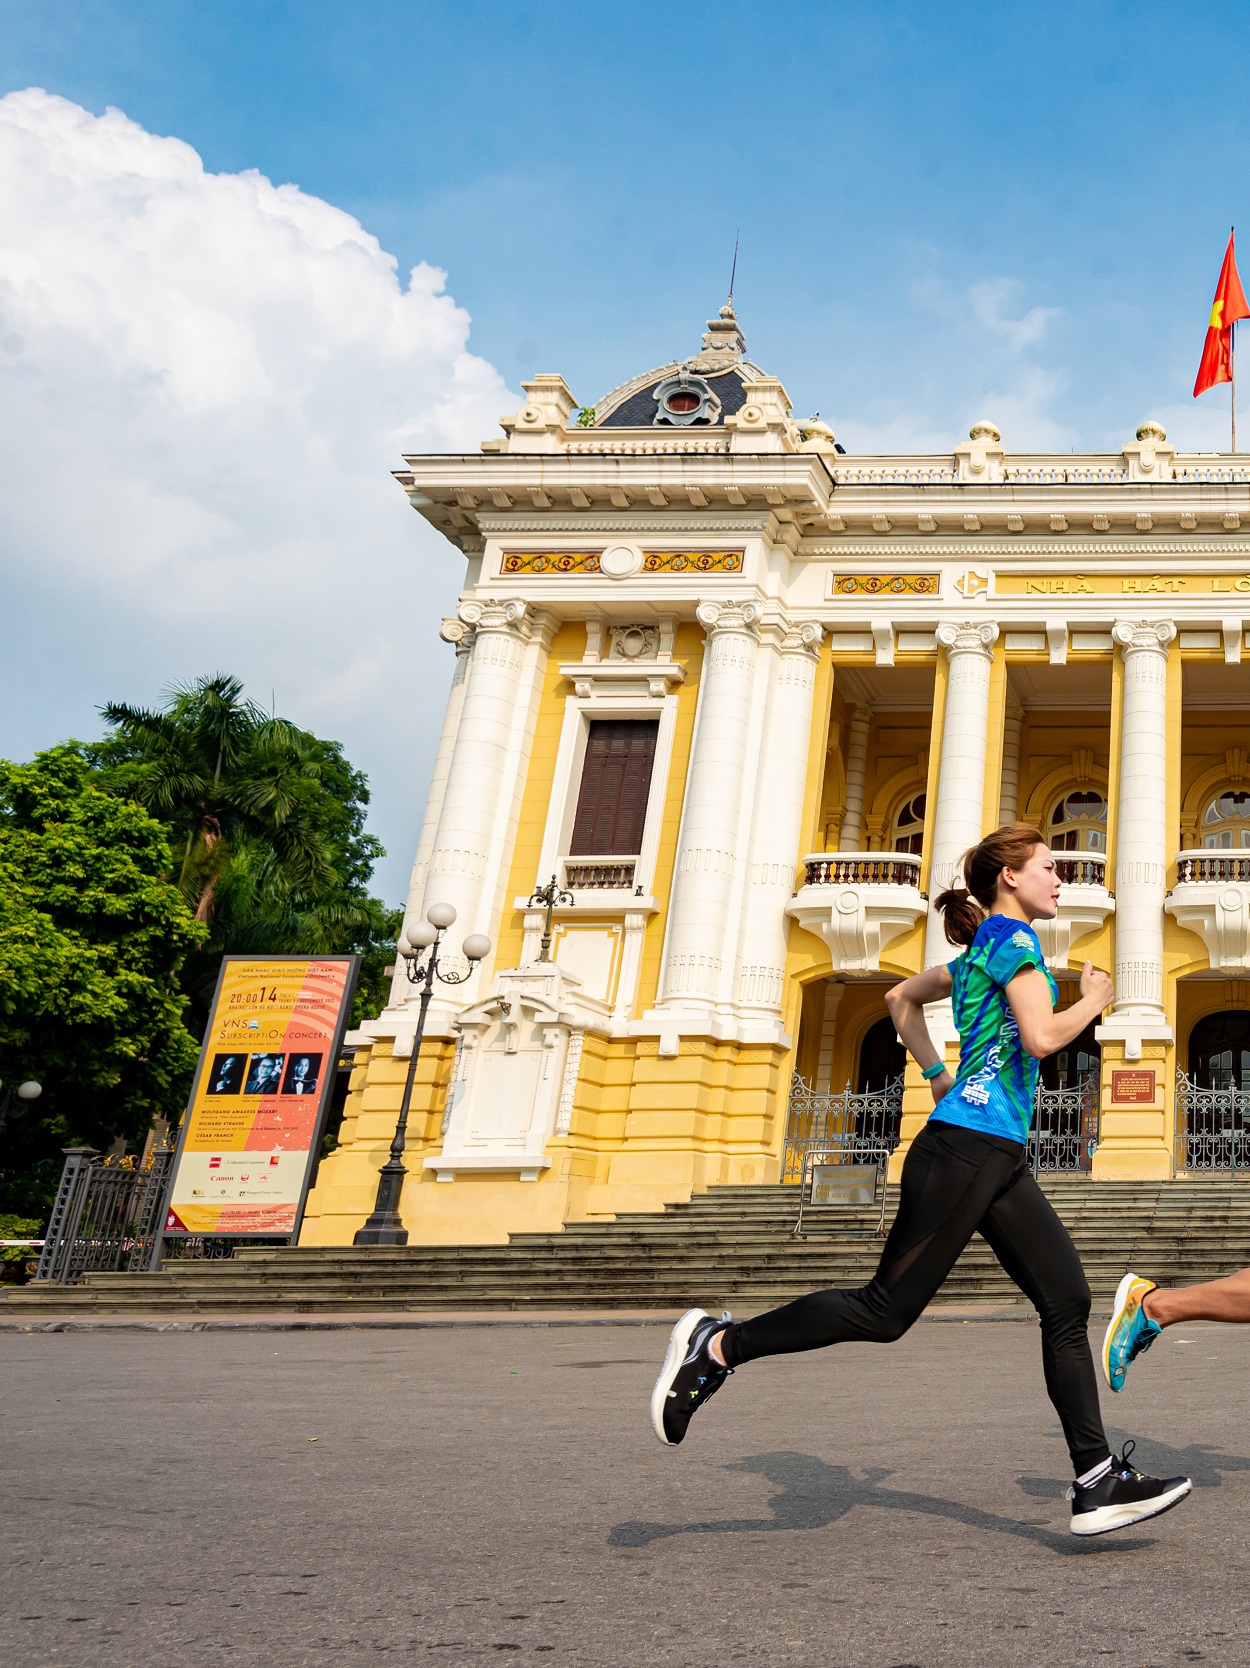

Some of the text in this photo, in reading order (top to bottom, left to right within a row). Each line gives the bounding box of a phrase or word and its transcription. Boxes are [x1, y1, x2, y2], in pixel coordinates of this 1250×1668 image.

[1025, 574, 1095, 593] NHÀ
[1121, 574, 1186, 593] HÁT
[230, 993, 258, 1003] 20:00
[260, 986, 277, 1003] 14
